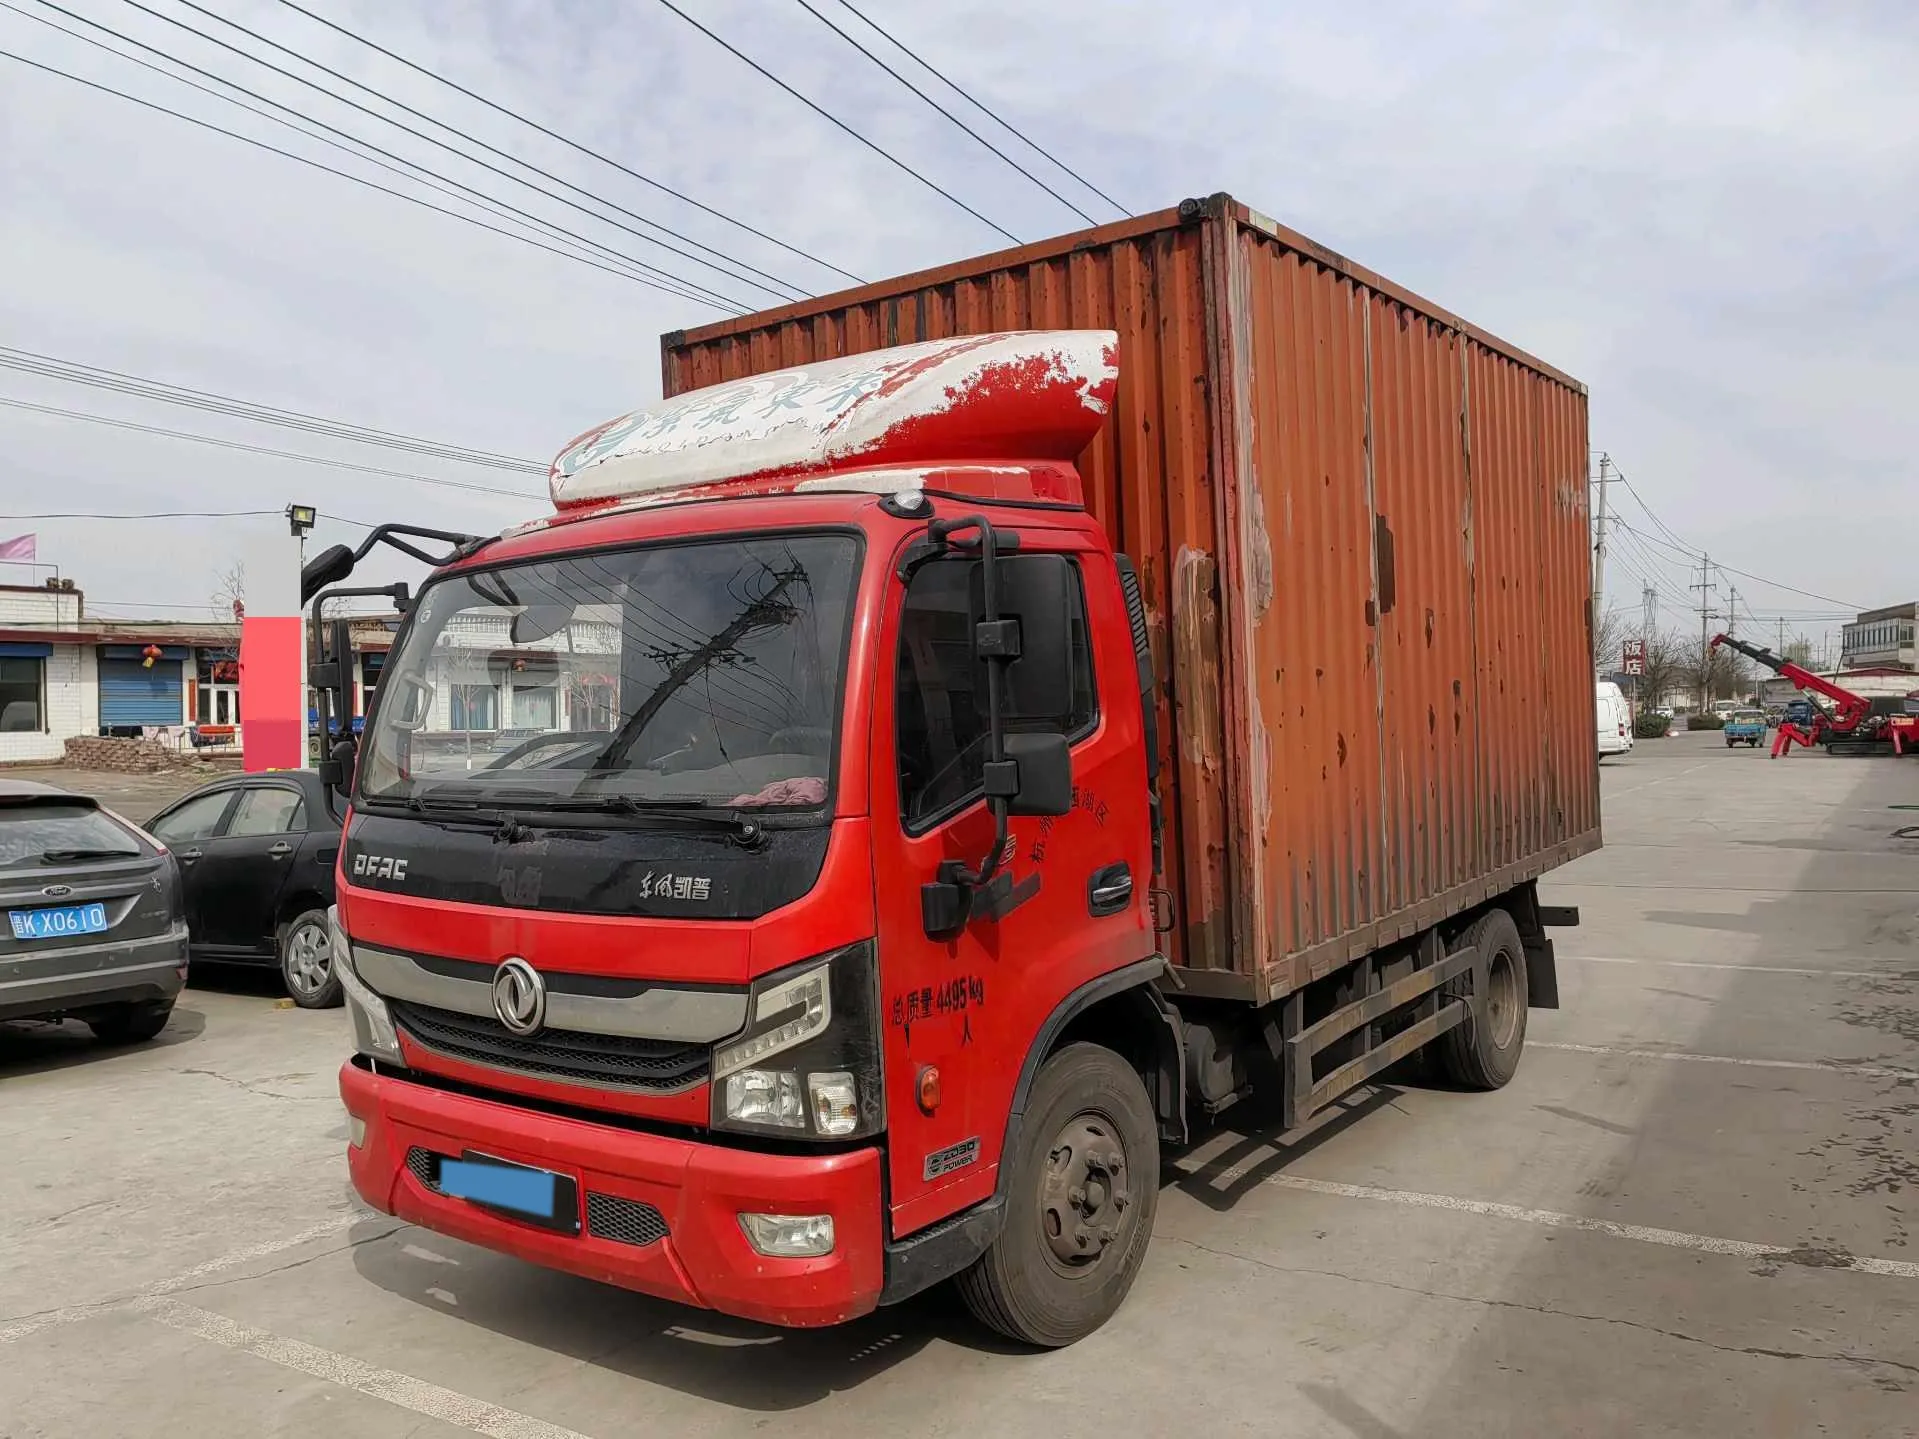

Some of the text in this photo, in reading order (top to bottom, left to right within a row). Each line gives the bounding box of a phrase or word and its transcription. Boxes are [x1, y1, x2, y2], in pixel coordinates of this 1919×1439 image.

[1624, 640, 1641, 675] 饭店
[353, 854, 408, 880] DFAC
[640, 871, 711, 900] 东风凯普
